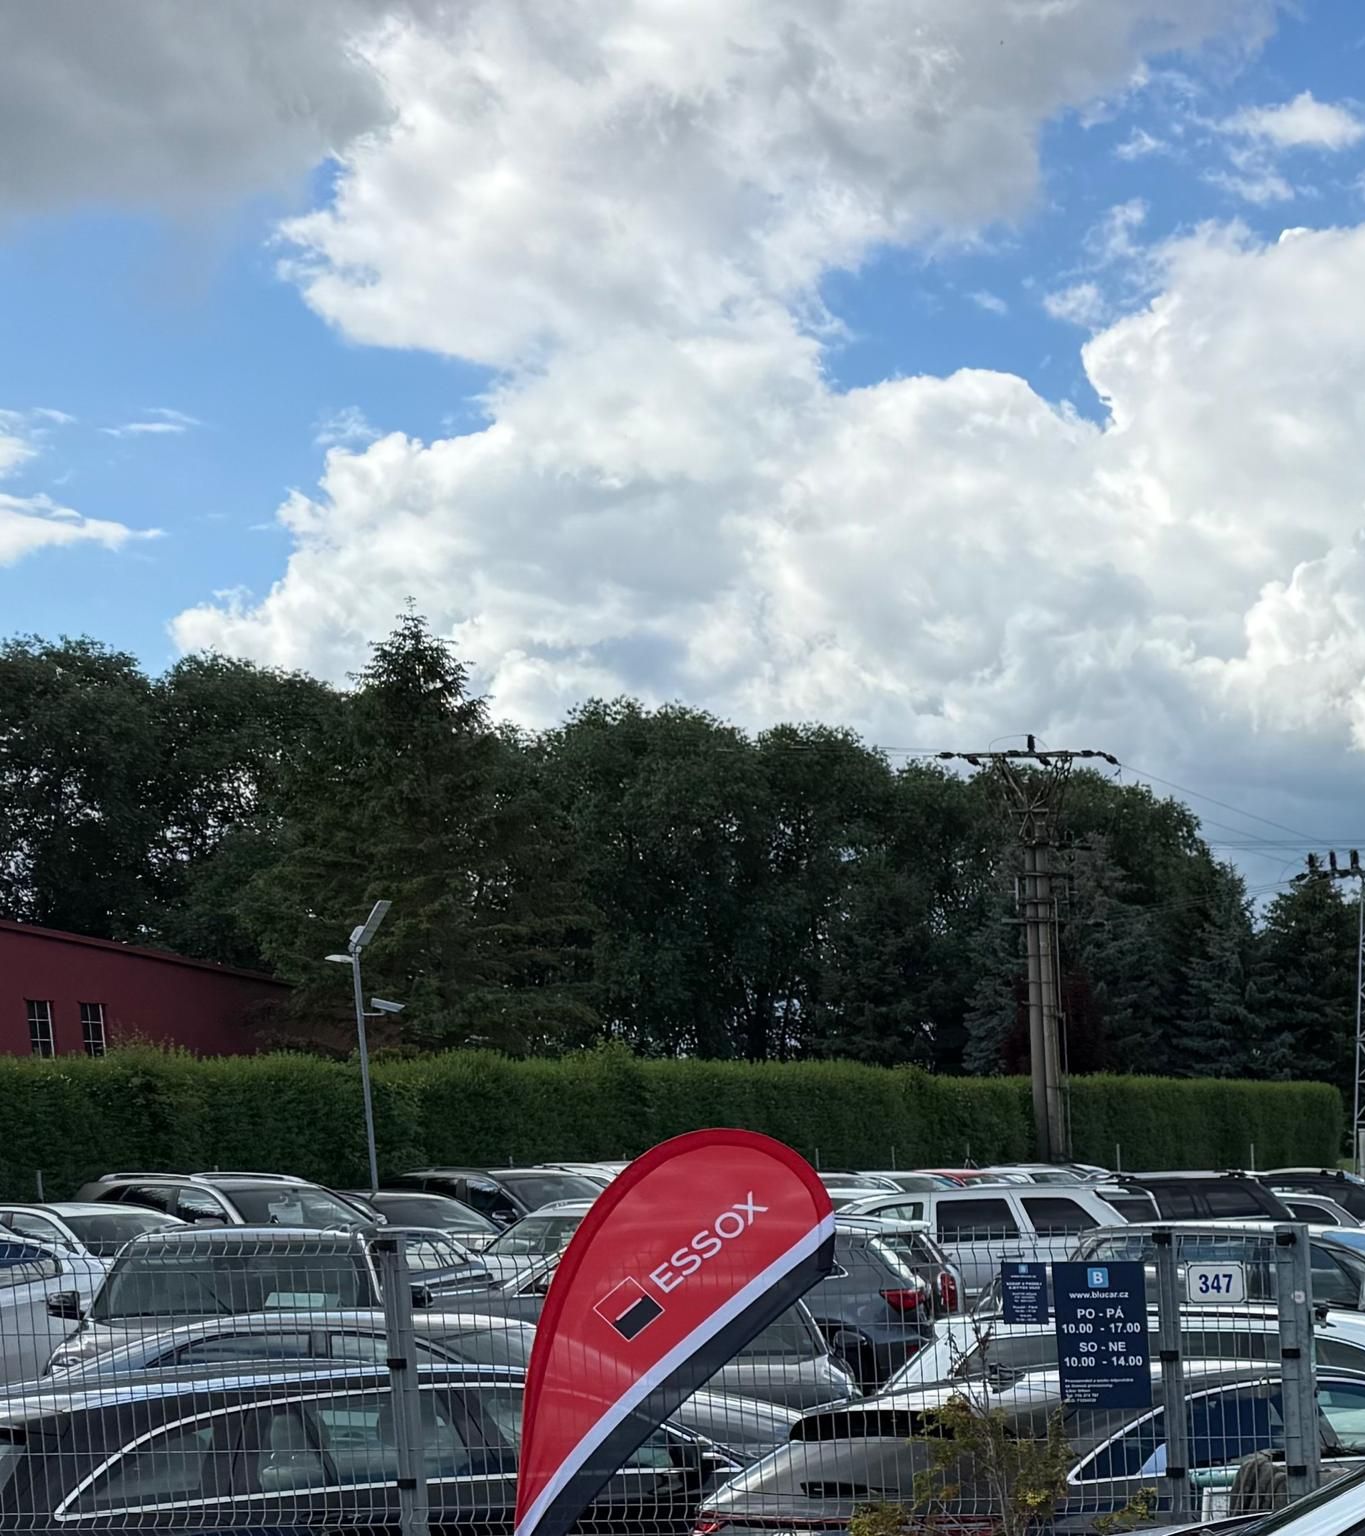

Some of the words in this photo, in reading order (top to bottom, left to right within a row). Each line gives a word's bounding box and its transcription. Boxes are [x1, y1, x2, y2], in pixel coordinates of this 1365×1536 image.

[649, 1190, 769, 1293] ESSOX
[1092, 1271, 1104, 1285] B
[1199, 1273, 1233, 1293] 347
[1068, 1291, 1129, 1299] www.blucar.cz
[1077, 1308, 1096, 1319] PO
[1106, 1305, 1124, 1318] PÁ
[1062, 1323, 1093, 1334] 10.00
[1109, 1322, 1141, 1333] 17.00
[1079, 1342, 1097, 1352] SO
[1108, 1341, 1126, 1352] NE
[1064, 1356, 1096, 1367] 10.00
[1111, 1356, 1143, 1367] 14.00
